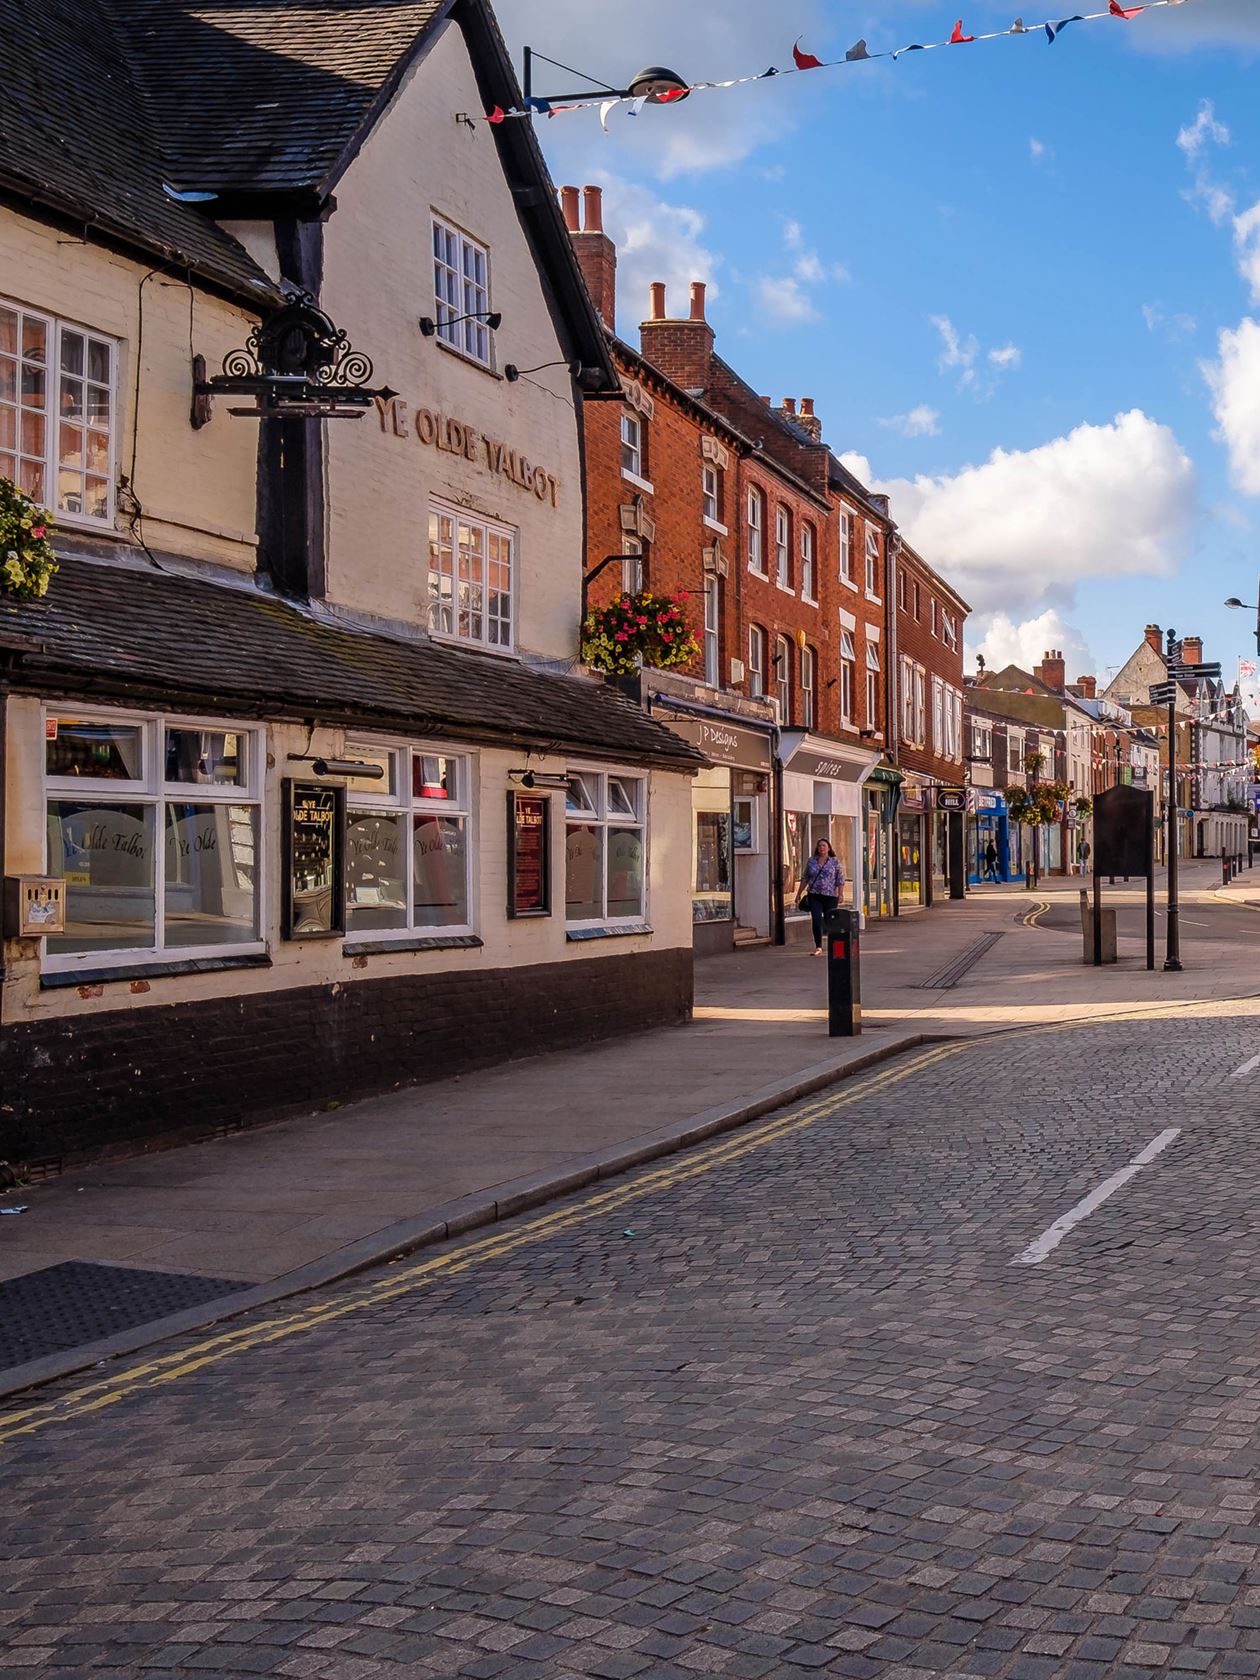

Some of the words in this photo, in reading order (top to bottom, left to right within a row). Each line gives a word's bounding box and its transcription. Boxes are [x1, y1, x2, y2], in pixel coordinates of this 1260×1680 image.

[373, 396, 408, 438] YE
[416, 408, 477, 462] OLDE
[481, 432, 561, 508] TALBOT
[697, 724, 703, 746] J
[704, 726, 710, 741] P
[814, 760, 841, 776] spires
[193, 827, 217, 852] Olde
